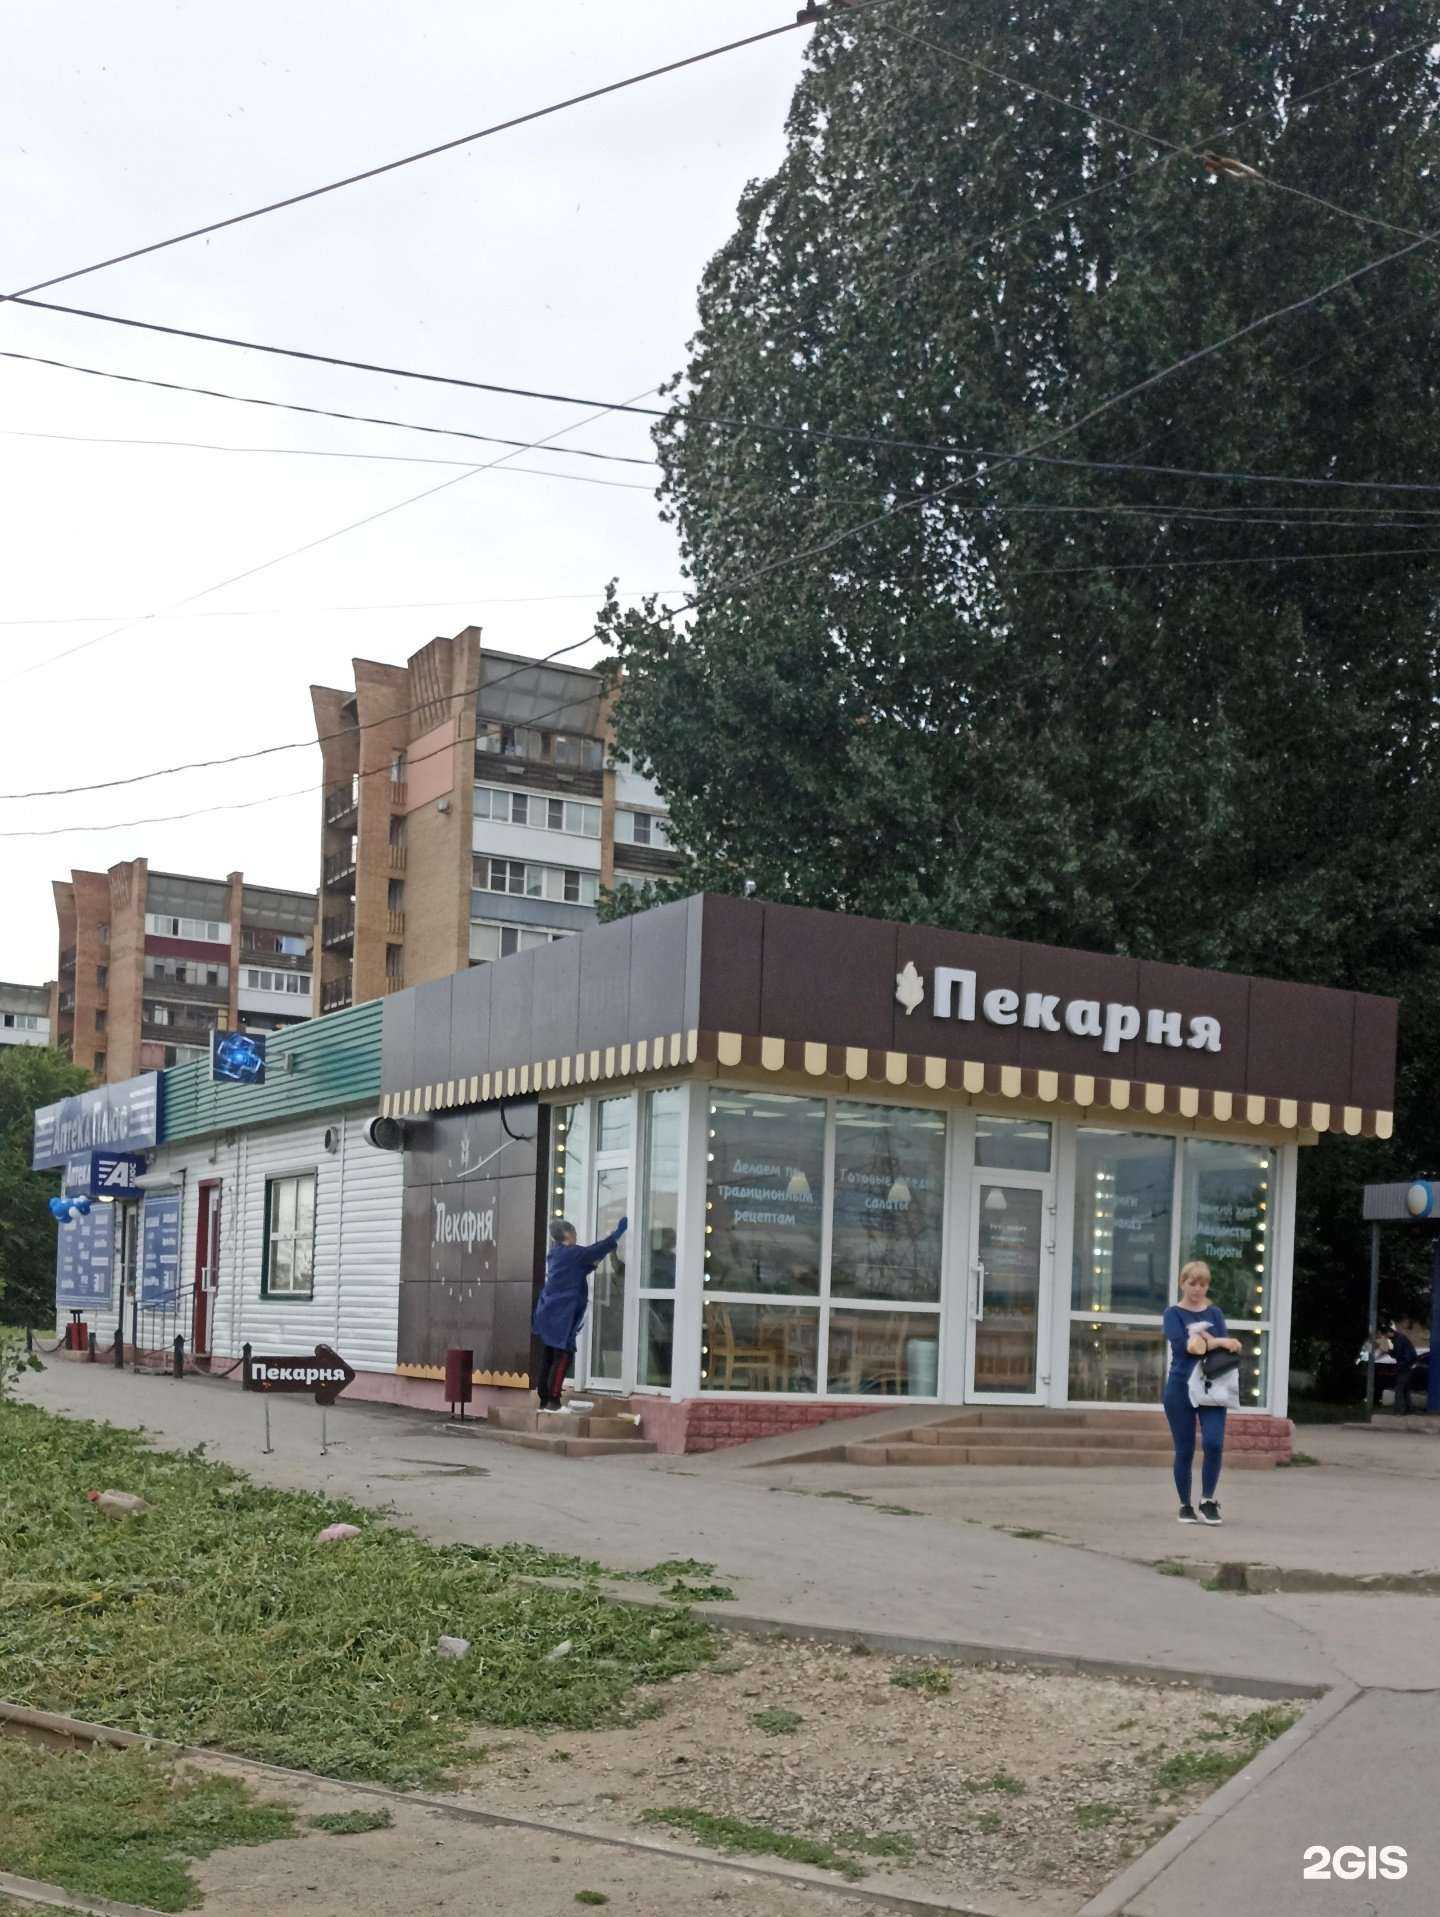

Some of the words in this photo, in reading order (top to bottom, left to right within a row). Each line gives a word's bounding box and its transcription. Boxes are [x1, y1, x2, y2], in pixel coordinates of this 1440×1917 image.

[933, 966, 1222, 1053] Пекарня
[436, 1202, 494, 1254] Пекарня
[733, 1209, 796, 1225] рецептам
[251, 1363, 346, 1385] Пекарня
